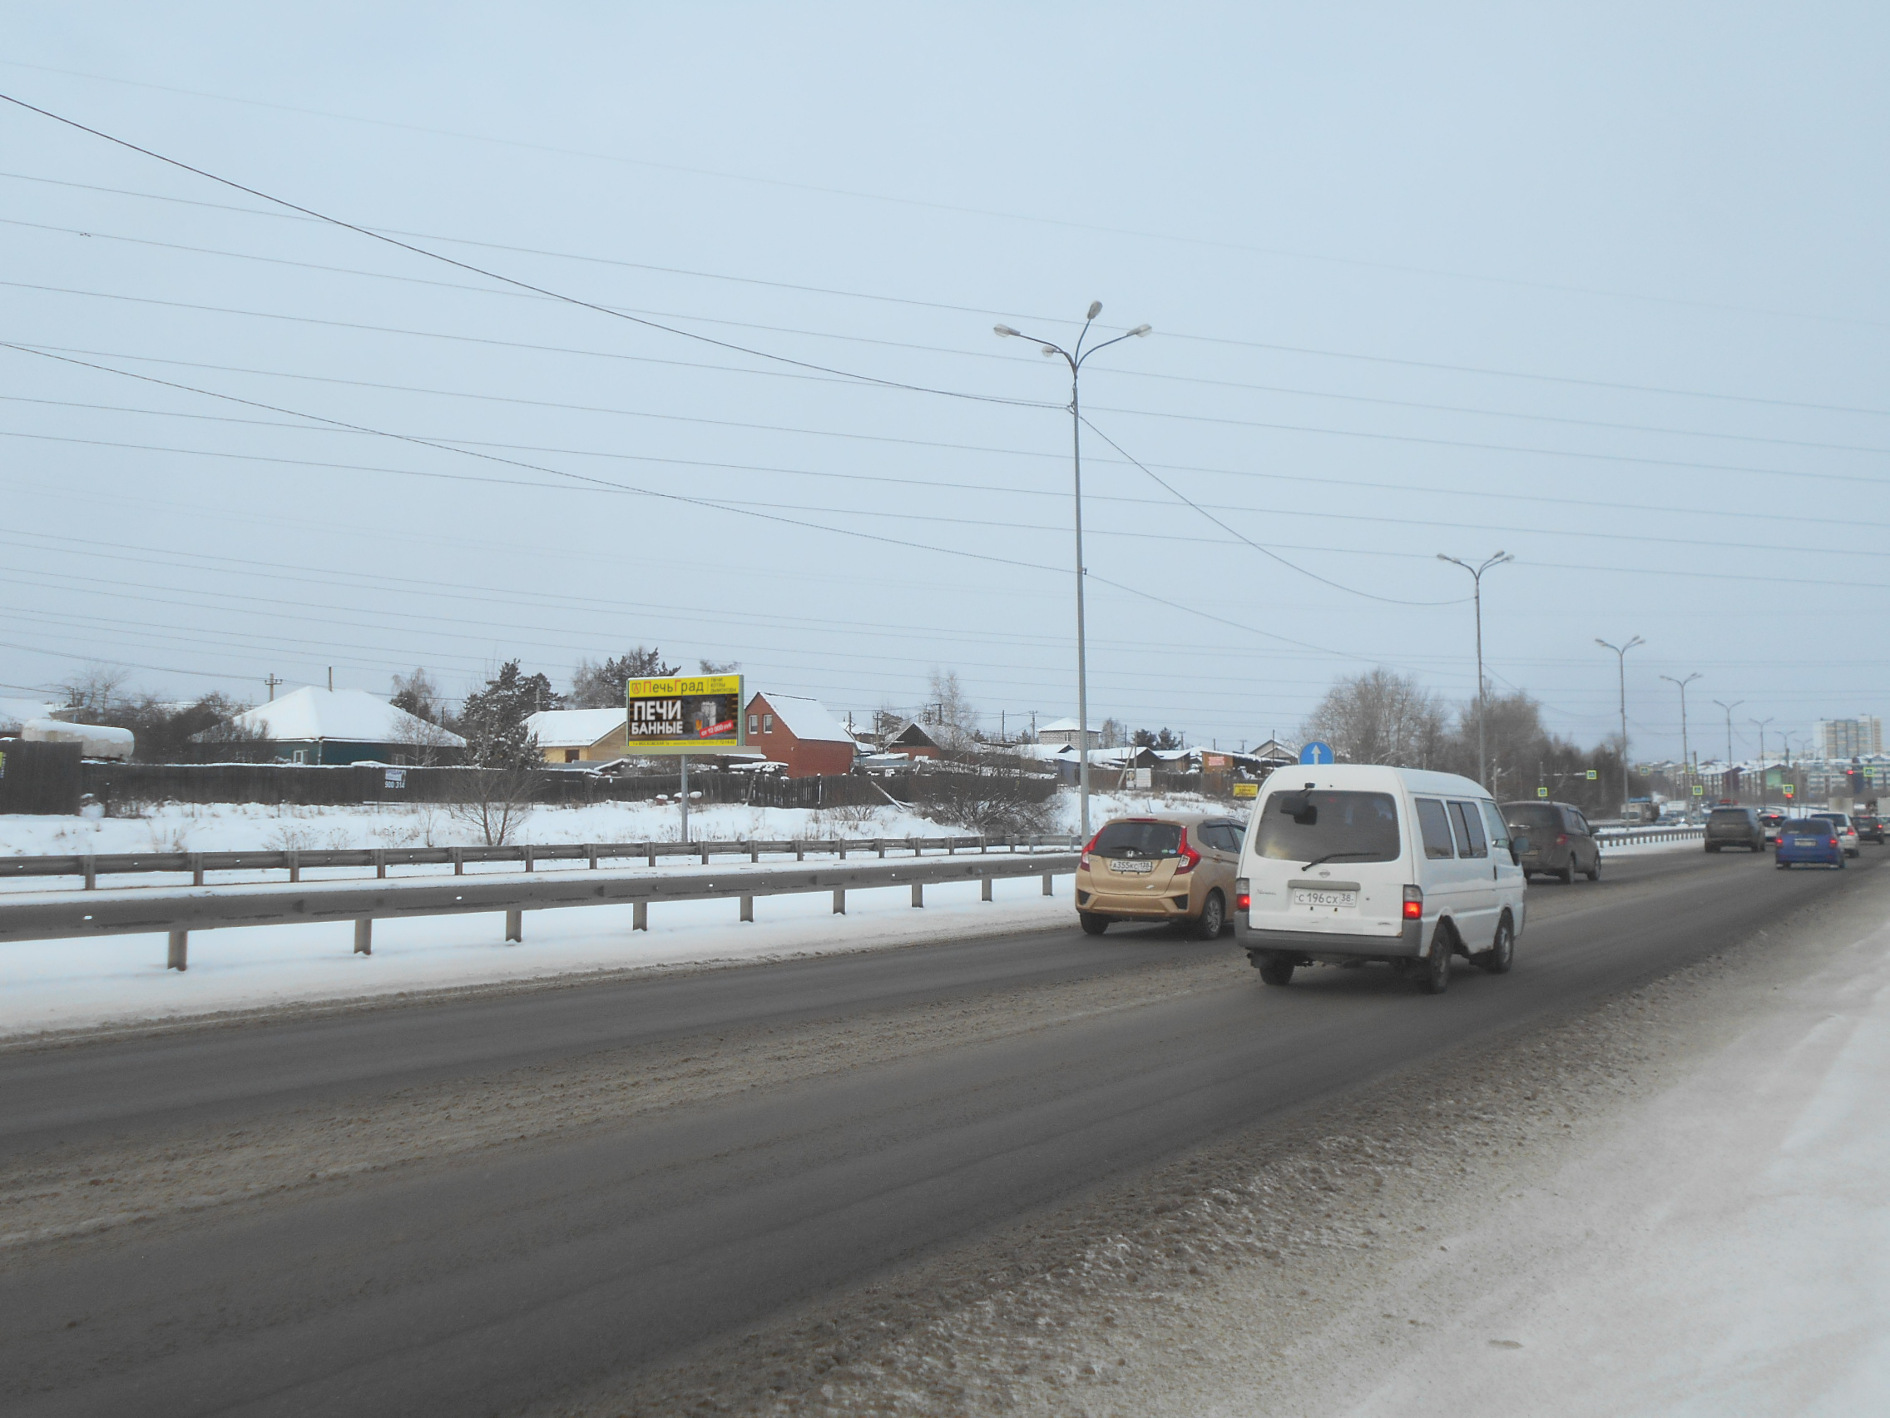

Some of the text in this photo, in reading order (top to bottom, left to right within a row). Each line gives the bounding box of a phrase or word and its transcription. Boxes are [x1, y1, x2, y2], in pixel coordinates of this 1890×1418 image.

[643, 680, 704, 694] ПечьГрад
[633, 700, 682, 721] ПЕЧИ
[631, 721, 683, 735] БАННЫЕ
